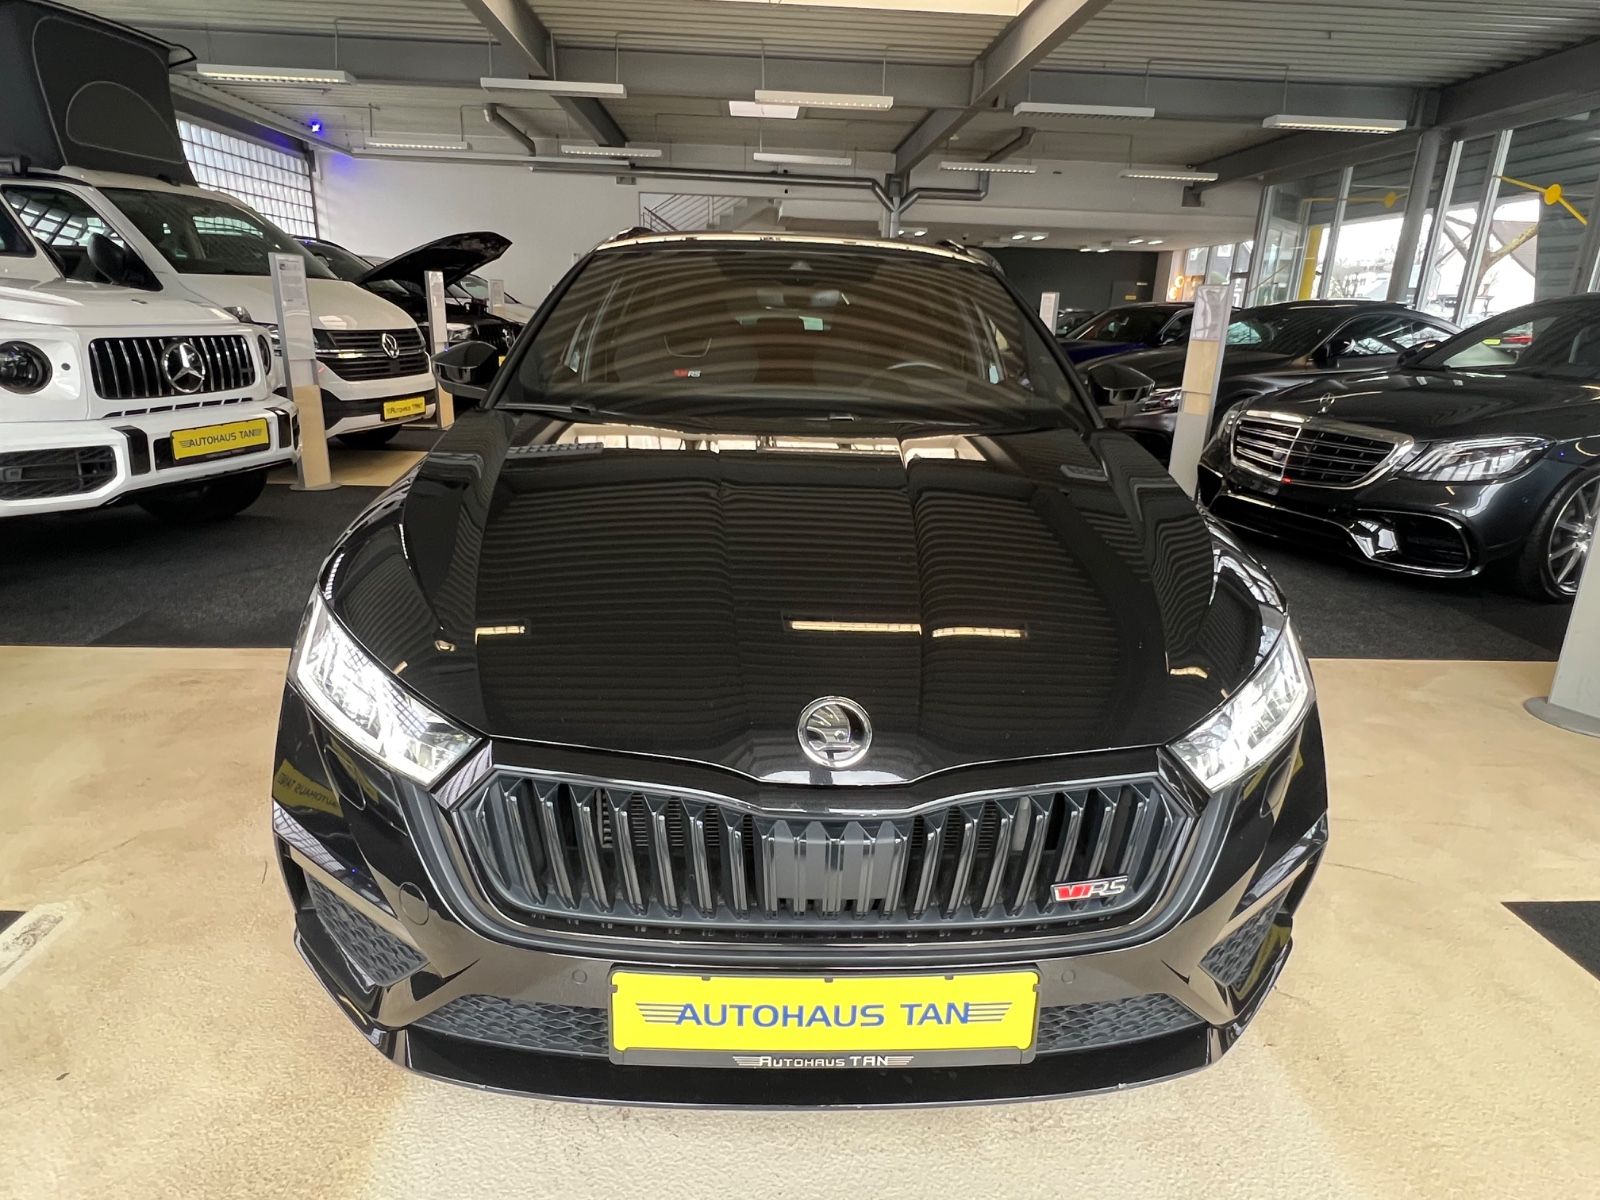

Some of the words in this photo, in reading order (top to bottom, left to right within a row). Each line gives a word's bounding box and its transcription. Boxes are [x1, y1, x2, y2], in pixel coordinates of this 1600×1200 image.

[189, 433, 236, 447] AUTOHAUS
[239, 429, 255, 439] TAN
[675, 1002, 885, 1028] AUTOHAUS
[900, 1001, 970, 1026] TAN
[849, 1055, 888, 1067] TAN
